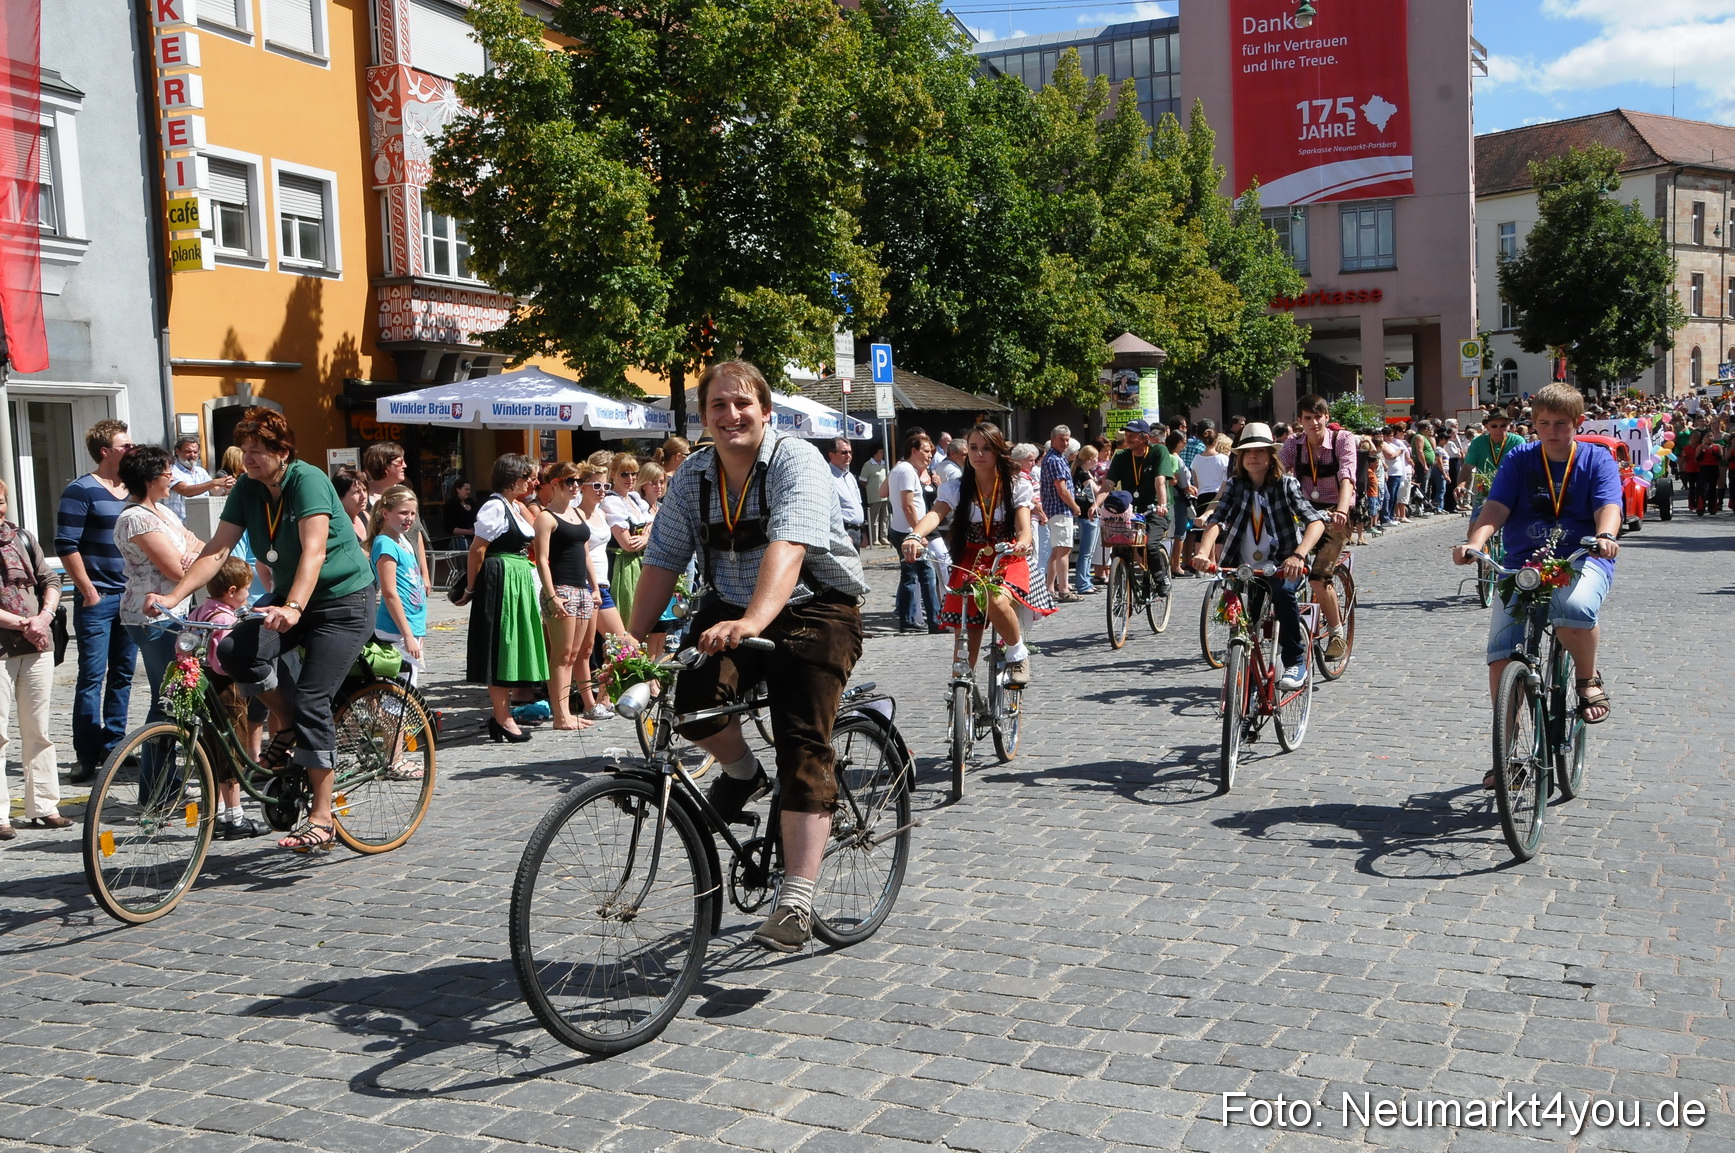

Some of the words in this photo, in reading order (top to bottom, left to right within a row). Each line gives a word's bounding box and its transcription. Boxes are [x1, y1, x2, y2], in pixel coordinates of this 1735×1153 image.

[1242, 44, 1260, 56] für
[1263, 42, 1281, 54] Ihr
[1283, 36, 1348, 52] Vertrauen
[1243, 60, 1268, 73] und
[1271, 57, 1295, 71] Ihre
[1298, 54, 1339, 68] Treue.
[1296, 96, 1356, 124] 175
[1298, 121, 1357, 141] JAHRE
[1298, 147, 1332, 156] Sparkasse
[1333, 141, 1397, 153] Neumarkt-Parsberg
[169, 202, 199, 225] café
[876, 349, 888, 379] P
[390, 402, 427, 415] Winkler
[429, 402, 450, 415] Bräu
[492, 403, 532, 416] Winkler
[534, 403, 558, 417] Bräu
[777, 413, 794, 426] Bräu
